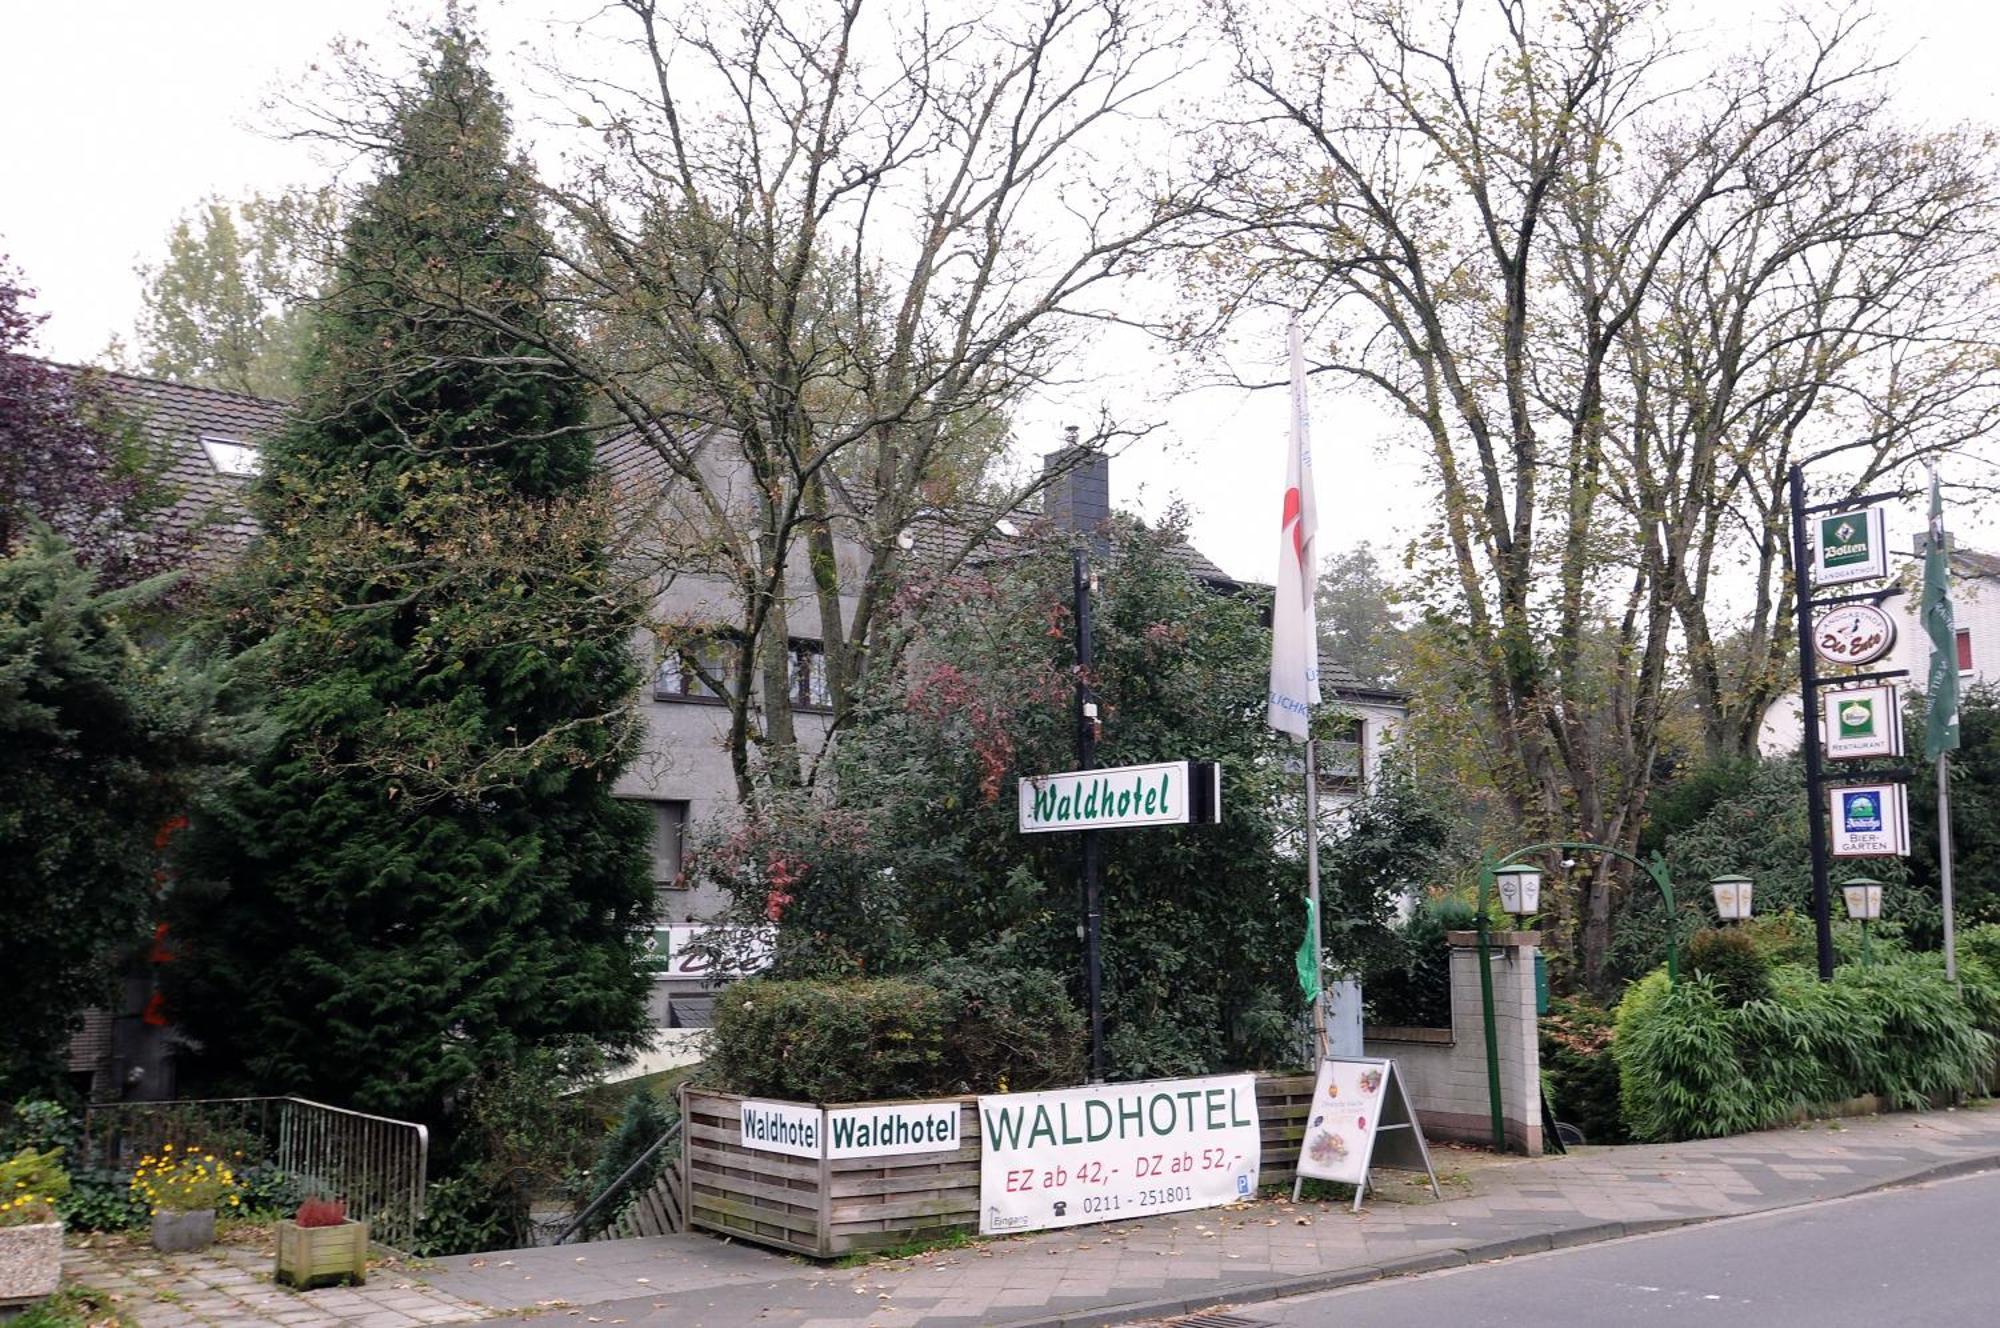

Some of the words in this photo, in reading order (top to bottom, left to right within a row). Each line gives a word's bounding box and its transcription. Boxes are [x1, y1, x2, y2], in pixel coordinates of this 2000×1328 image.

[1032, 773, 1169, 822] Waldhotel
[1842, 842, 1887, 850] GARTEN
[1850, 834, 1880, 842] BIER-
[744, 1108, 819, 1149] Waldhotel
[833, 1111, 956, 1149] Waldhotel
[984, 1088, 1251, 1152] WALDHOTEL
[1006, 1168, 1034, 1193] EZ
[1043, 1165, 1068, 1189] ab
[1076, 1161, 1119, 1186] 42,-
[1135, 1154, 1163, 1178] DZ
[1171, 1151, 1193, 1173] ab
[1201, 1147, 1243, 1172] 52,-
[1083, 1194, 1121, 1214] 0211
[1139, 1186, 1192, 1206] 251801
